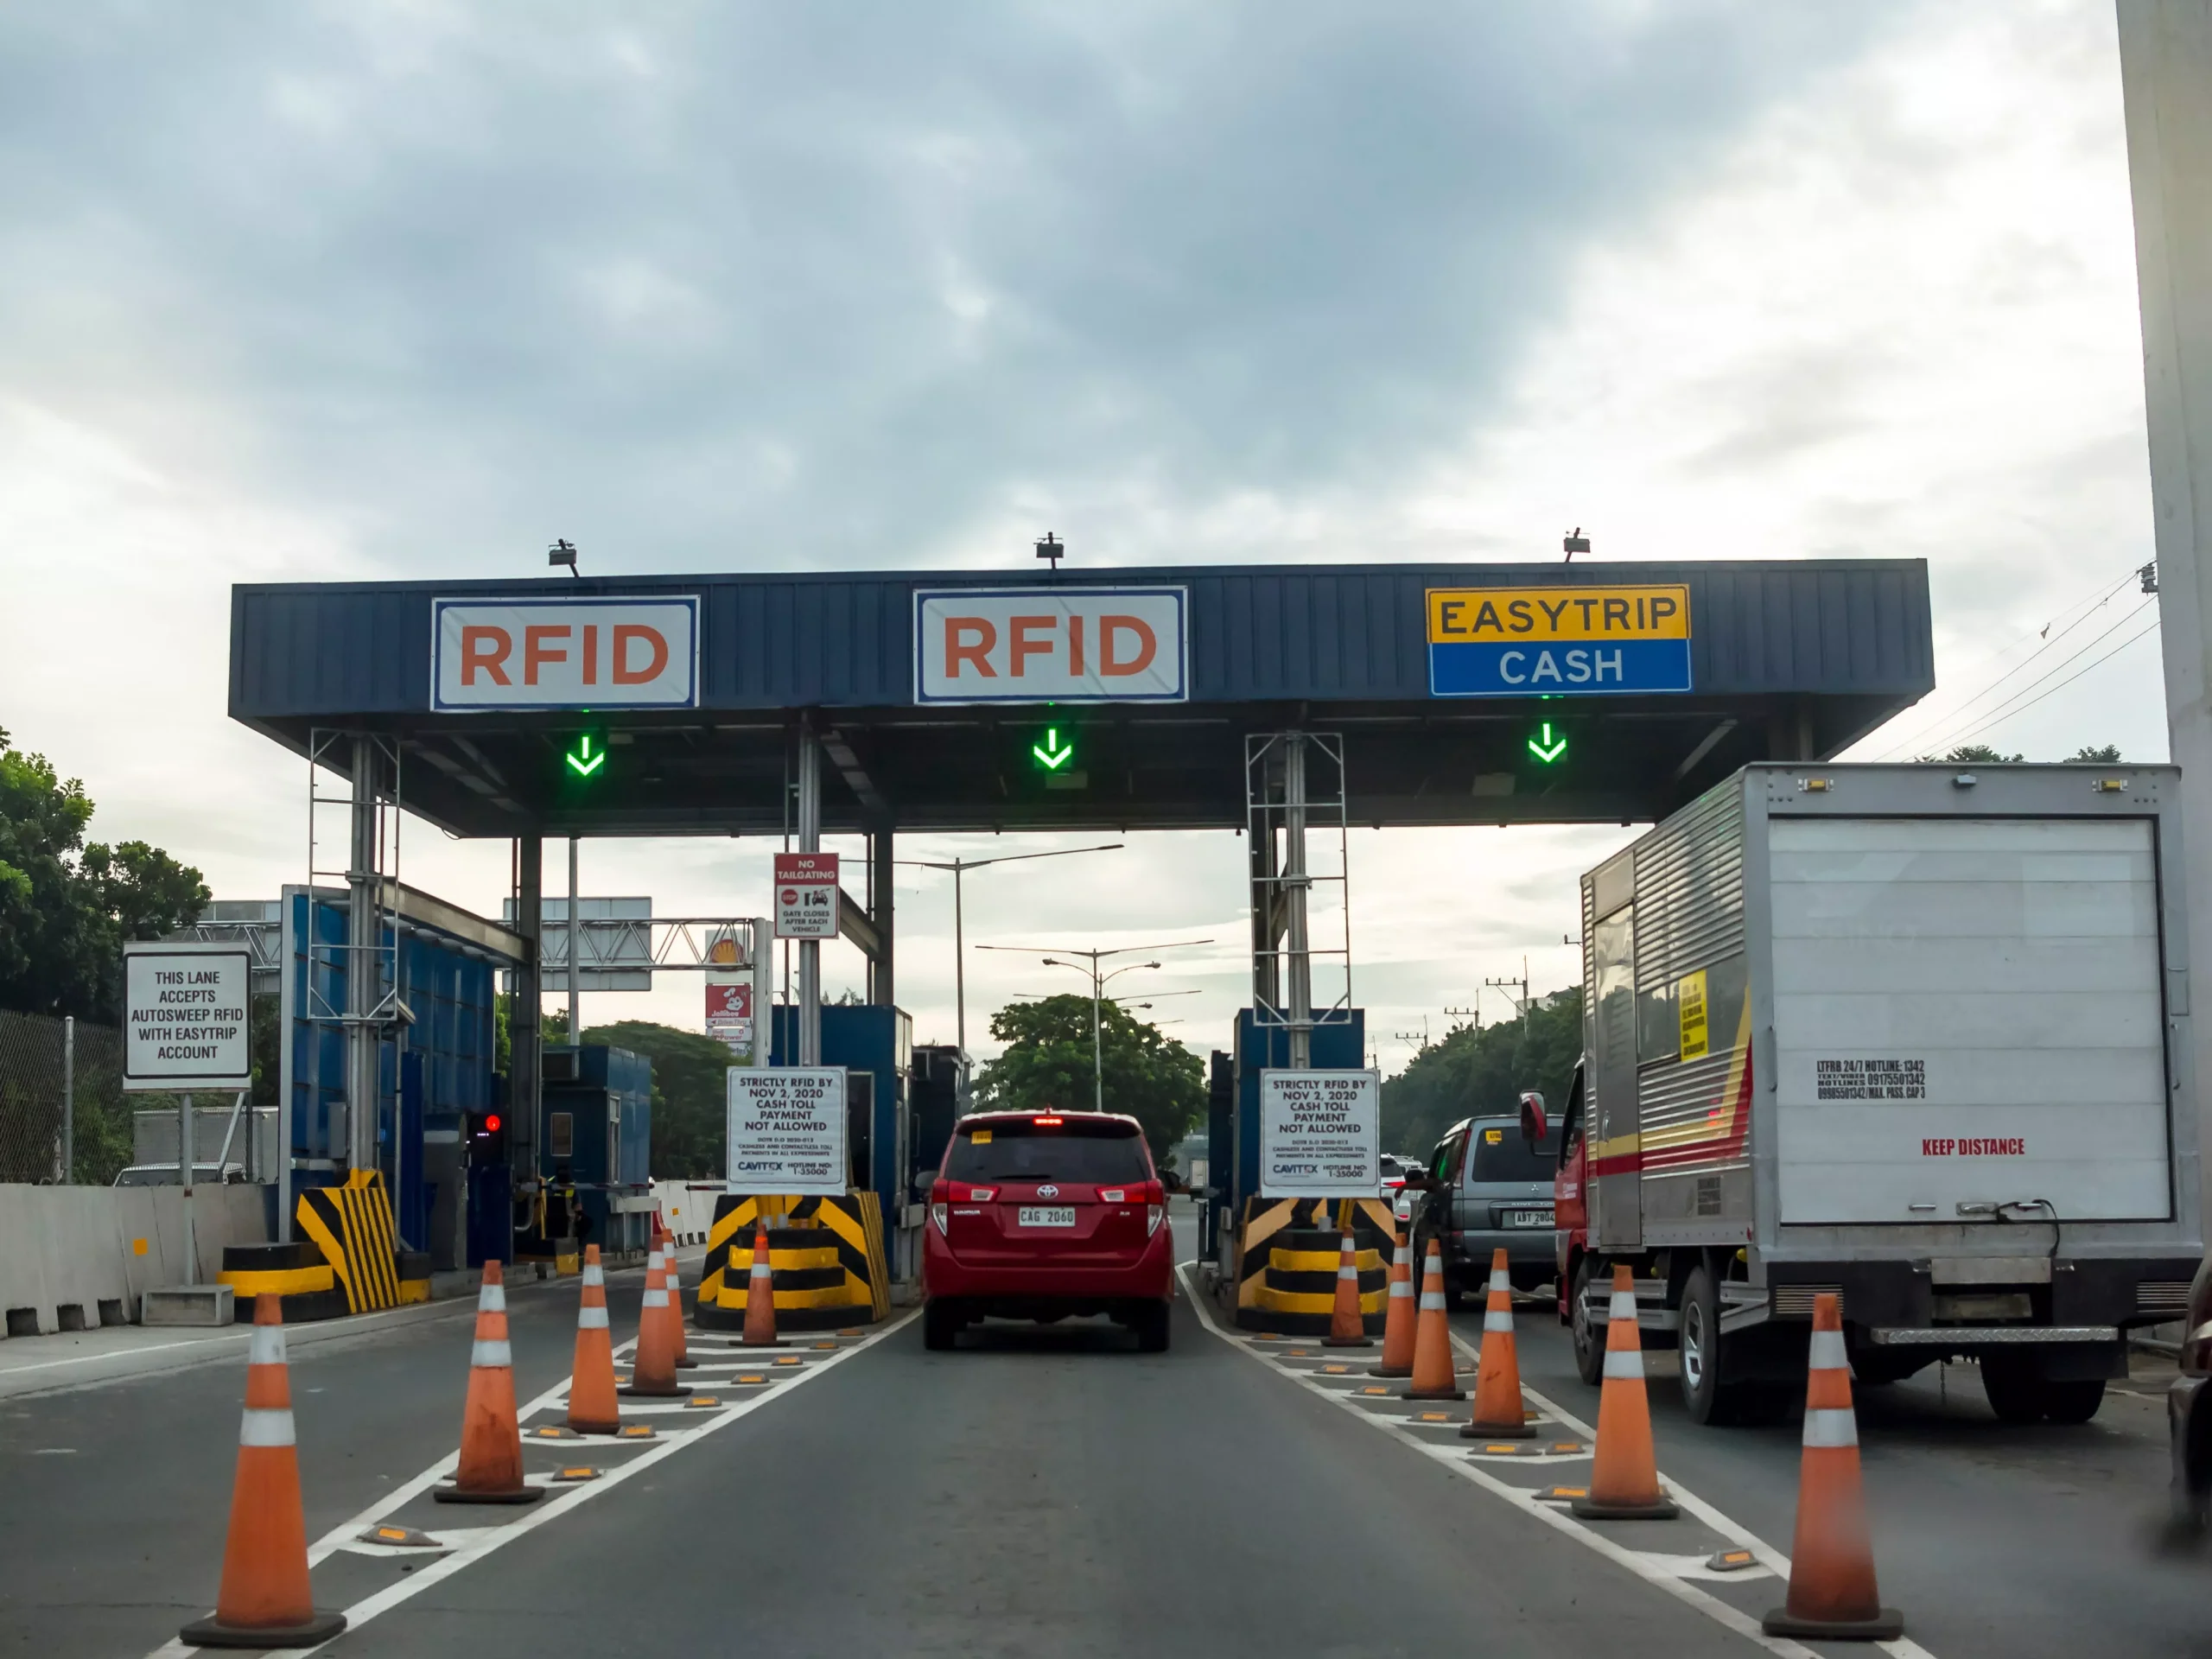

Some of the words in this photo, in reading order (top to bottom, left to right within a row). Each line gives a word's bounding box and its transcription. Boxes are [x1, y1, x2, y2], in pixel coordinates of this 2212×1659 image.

[1440, 597, 1678, 635] EASYTRIP
[944, 614, 1156, 678] RFID
[461, 624, 669, 686] RFID
[1499, 649, 1624, 684] CASH
[798, 860, 815, 868] NO
[778, 871, 836, 880] TAILGATING
[156, 971, 184, 984] THIS
[188, 971, 220, 984] LANE
[159, 990, 216, 1003] ACCEPTS
[131, 1009, 210, 1022] AUTOSWEEP
[214, 1008, 244, 1021] RFID
[138, 1027, 172, 1040] WITH
[175, 1027, 238, 1040] EASYTRIP
[157, 1046, 219, 1059] ACCOUNT
[1817, 1060, 1841, 1072] LTFRB
[1844, 1060, 1863, 1072] 24/7
[1865, 1060, 1902, 1072] HOTLINE:
[1904, 1060, 1924, 1072] 1342
[740, 1077, 786, 1087] STRICTLY
[791, 1077, 815, 1087] RFID
[818, 1077, 833, 1087] BY
[1867, 1073, 1925, 1085] 09175501342
[1273, 1080, 1319, 1090] STRICTLY
[1324, 1080, 1349, 1089] RFID
[1352, 1080, 1366, 1089] BY
[749, 1089, 776, 1098] NOV
[779, 1089, 790, 1099] 2,
[795, 1089, 823, 1098] 2020
[1283, 1091, 1310, 1100] NOV
[1313, 1091, 1324, 1102] 2,
[1328, 1091, 1357, 1100] 2020
[1887, 1087, 1905, 1099] PASS.
[1906, 1087, 1919, 1099] CAP
[1921, 1087, 1925, 1099] 3
[756, 1100, 786, 1109] CASH
[791, 1100, 816, 1109] TOLL
[1290, 1103, 1320, 1111] CASH
[1325, 1103, 1350, 1111] TOLL
[760, 1111, 812, 1120] PAYMENT
[1294, 1113, 1346, 1122] PAYMENT
[745, 1122, 769, 1131] NOT
[772, 1122, 827, 1131] ALLOWED
[1279, 1124, 1304, 1133] NOT
[1307, 1124, 1361, 1134] ALLOWED
[1922, 1139, 1955, 1155] KEEP
[1958, 1138, 2025, 1155] DISTANCE
[738, 1161, 783, 1171] CAVITEX
[1273, 1164, 1318, 1173] CAVITEX
[1020, 1211, 1040, 1222] CAG
[1047, 1211, 1073, 1222] 2060
